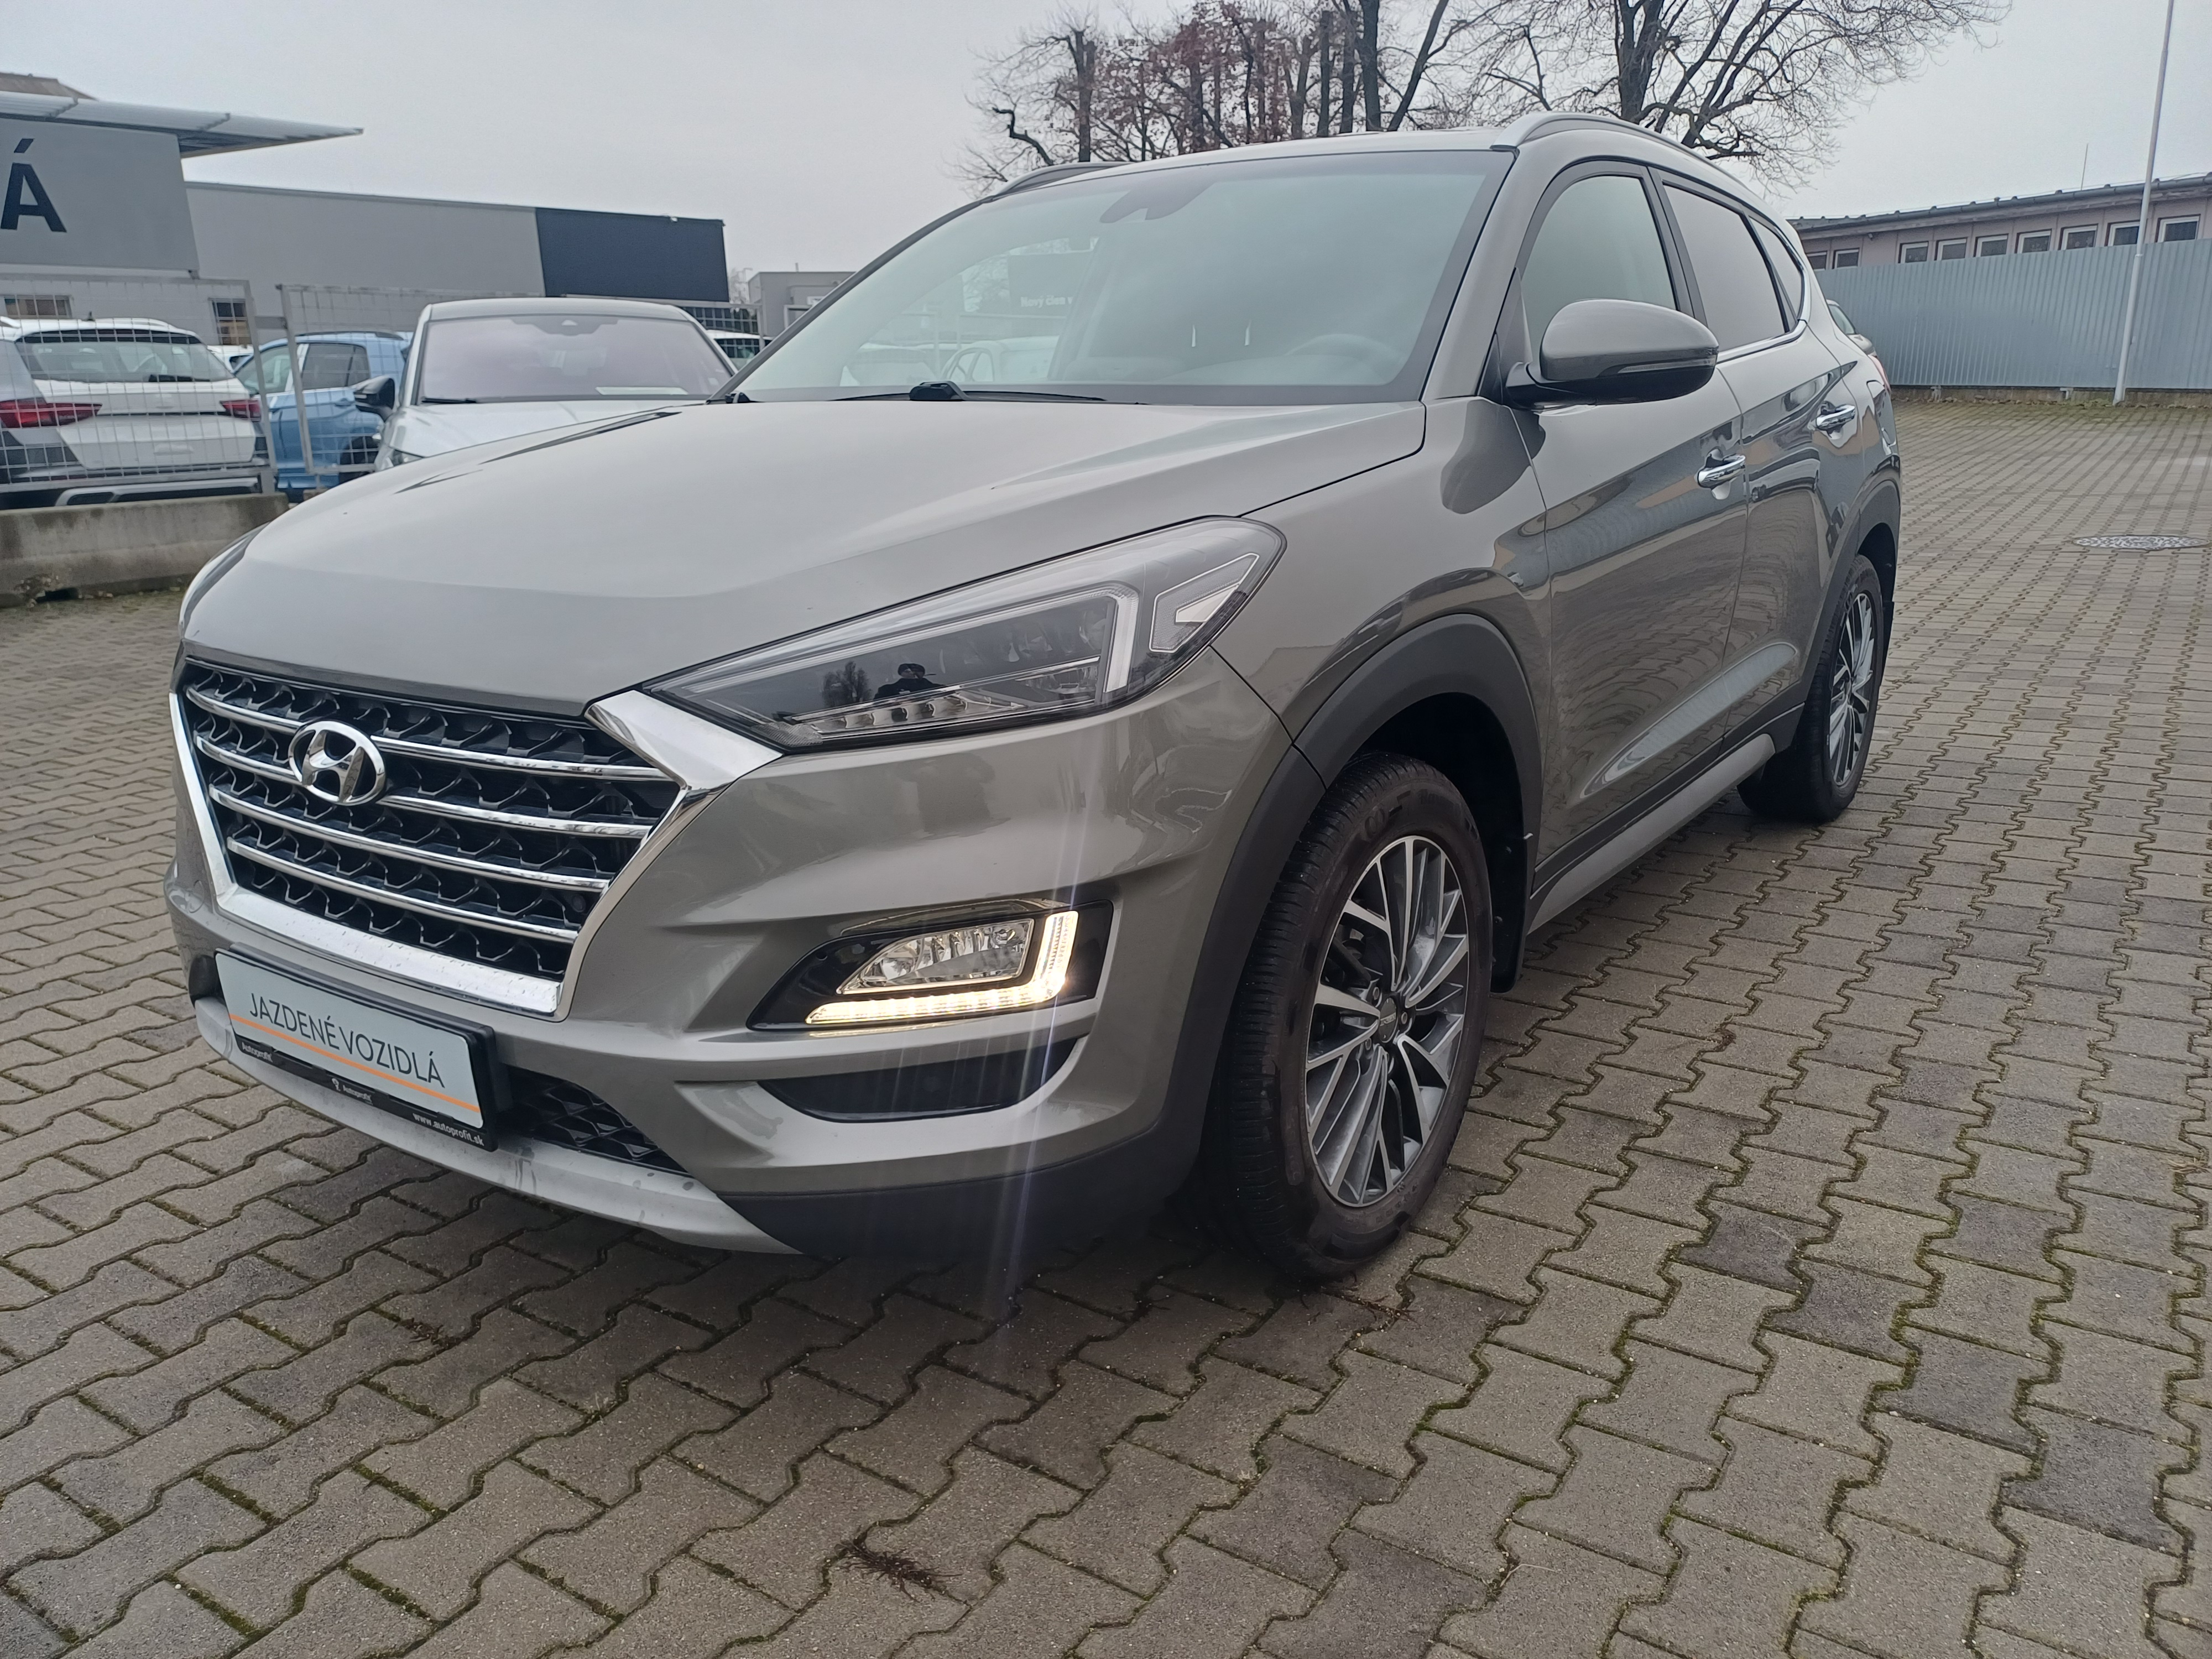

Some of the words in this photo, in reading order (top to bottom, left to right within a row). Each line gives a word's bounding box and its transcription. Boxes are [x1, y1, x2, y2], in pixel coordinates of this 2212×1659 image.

[249, 993, 340, 1051] JAZDENÉ
[338, 1026, 446, 1088] VOZIDLÁ
[412, 1113, 484, 1146] www.autoprofit.sk
